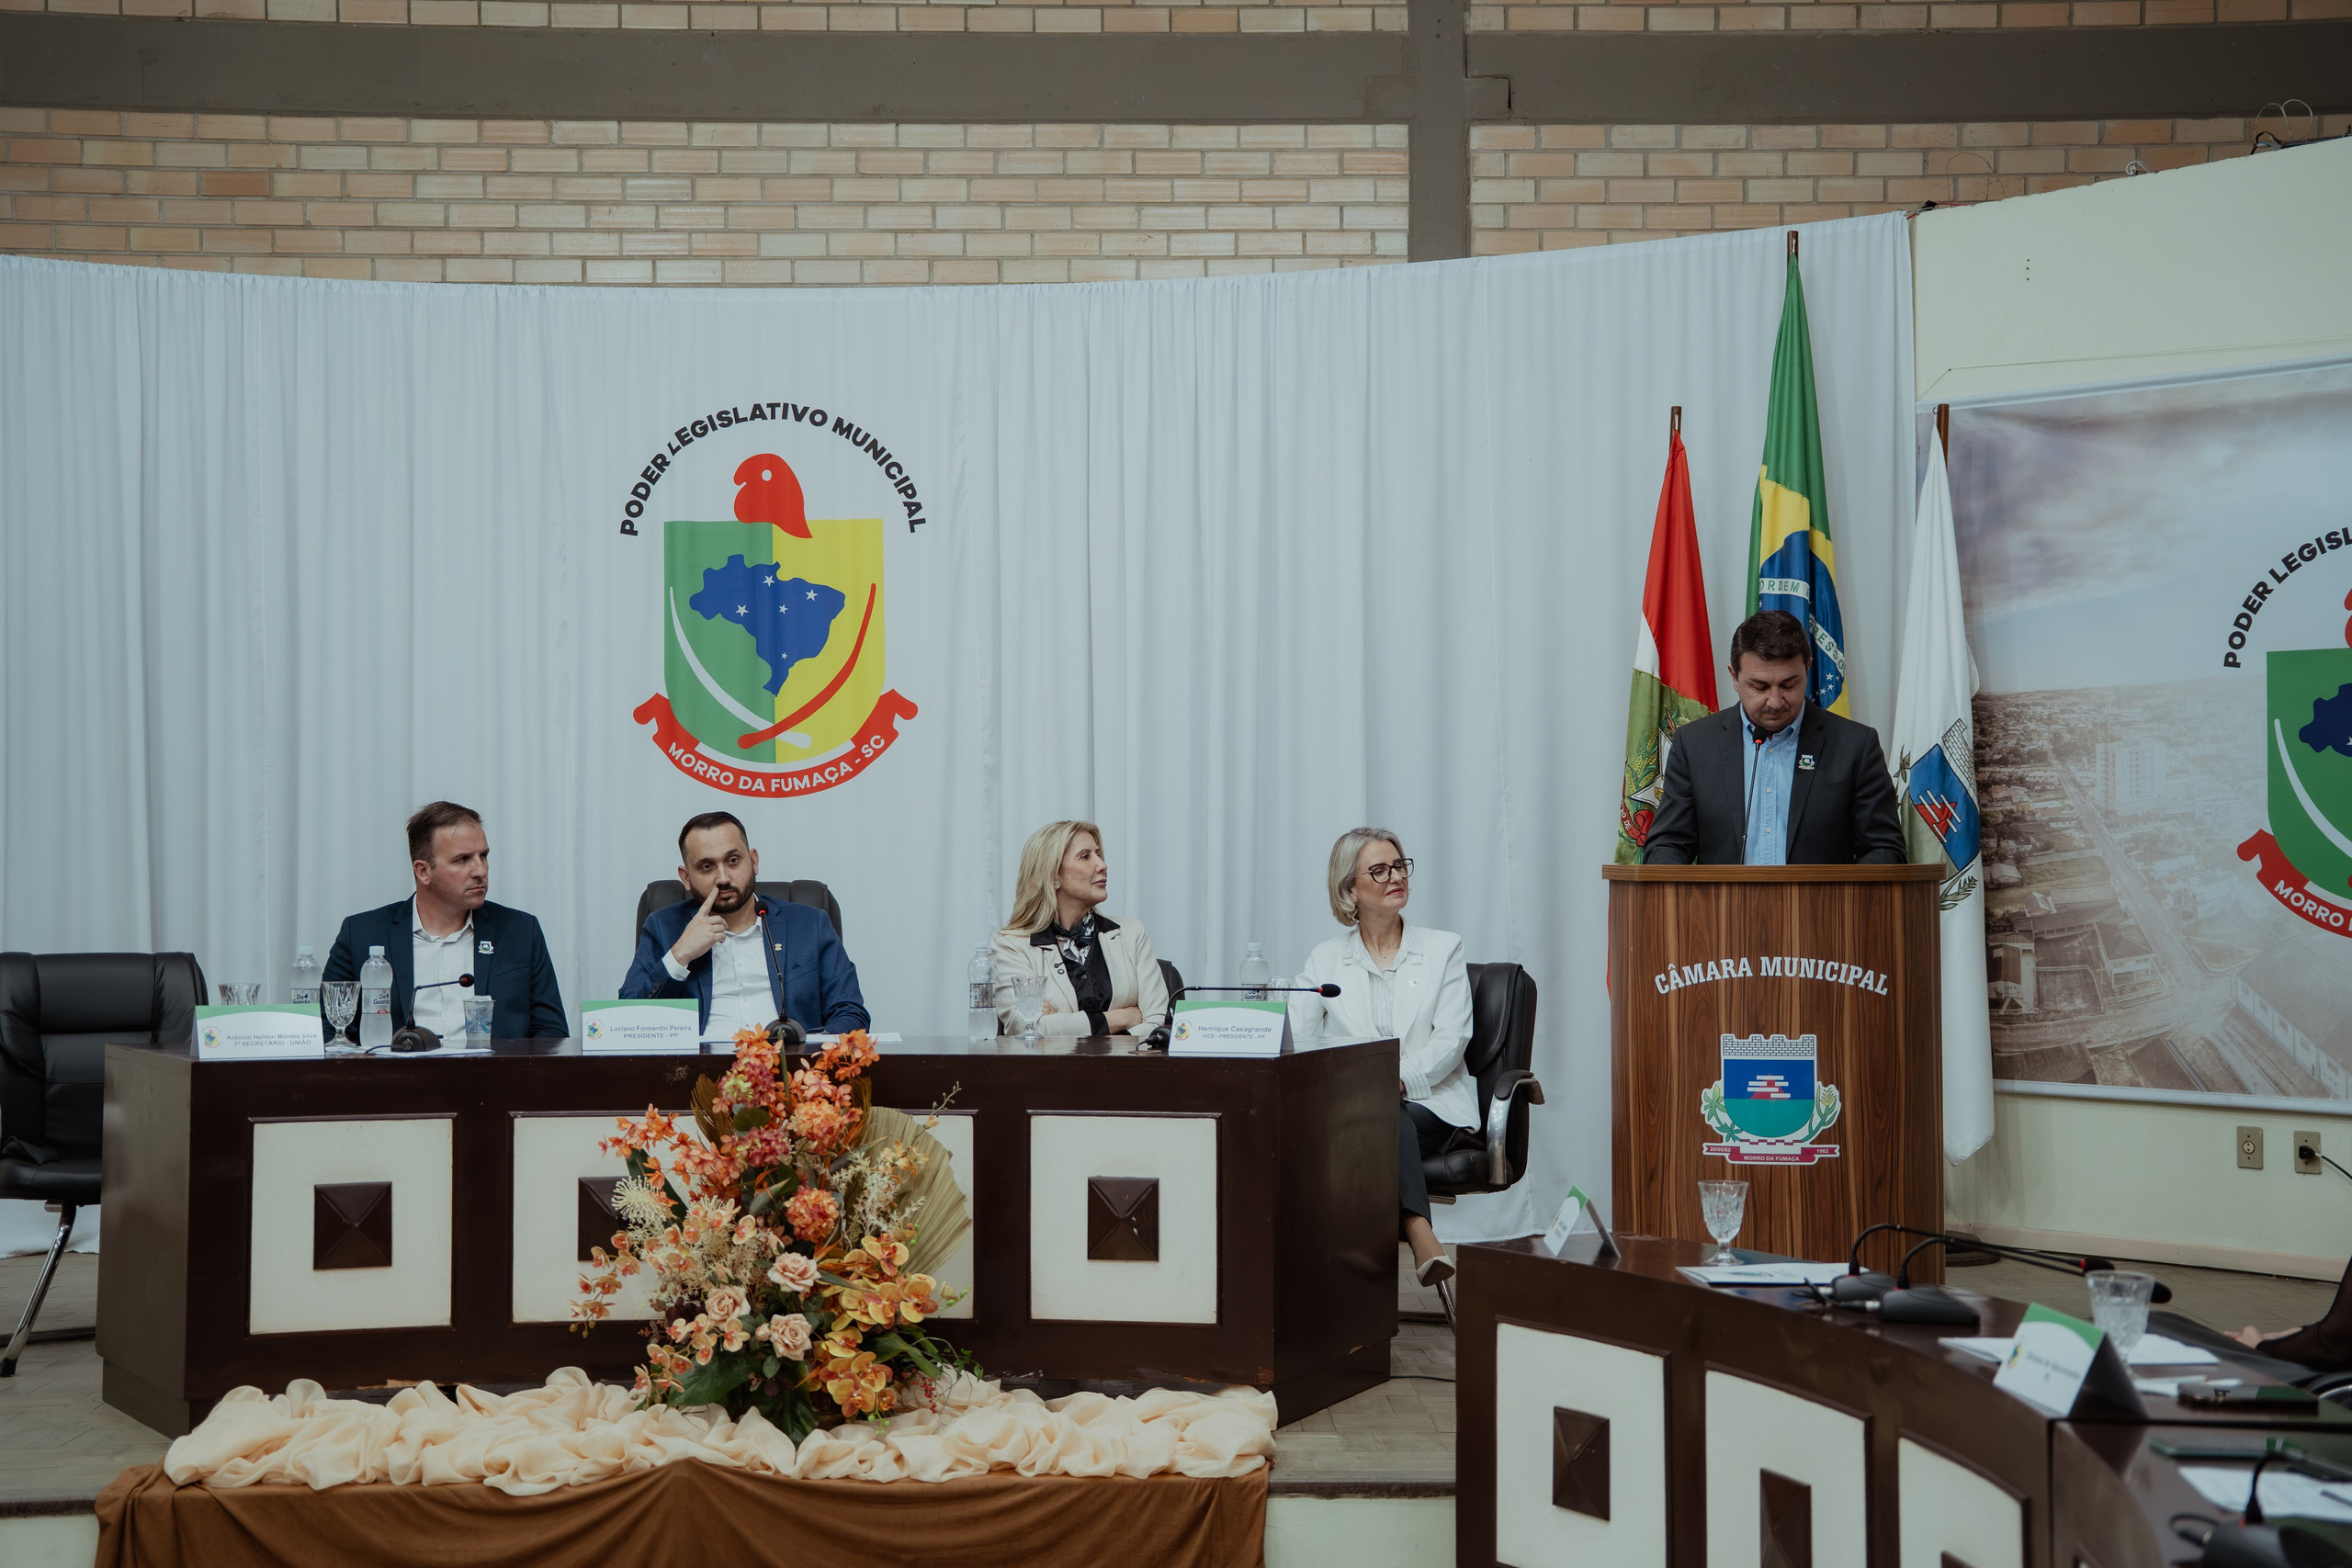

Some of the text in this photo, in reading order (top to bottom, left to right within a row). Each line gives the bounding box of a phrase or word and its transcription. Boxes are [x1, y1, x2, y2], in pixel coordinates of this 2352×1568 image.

[619, 402, 927, 537] PODER LEGISLATIVO MUNICIPAL
[2223, 526, 2352, 669] PODER LEGISL
[1809, 616, 1845, 671] GRESSO
[668, 742, 734, 786] MORRO
[739, 775, 766, 792] DA
[771, 757, 854, 793] FUMAÇA
[861, 734, 886, 760] SC
[2274, 879, 2345, 928] MORRO
[1654, 956, 1889, 996] CÂMARA MUNICIPAL
[241, 1039, 285, 1047] SECRETÁRIO
[1230, 1025, 1272, 1033] Casagrande
